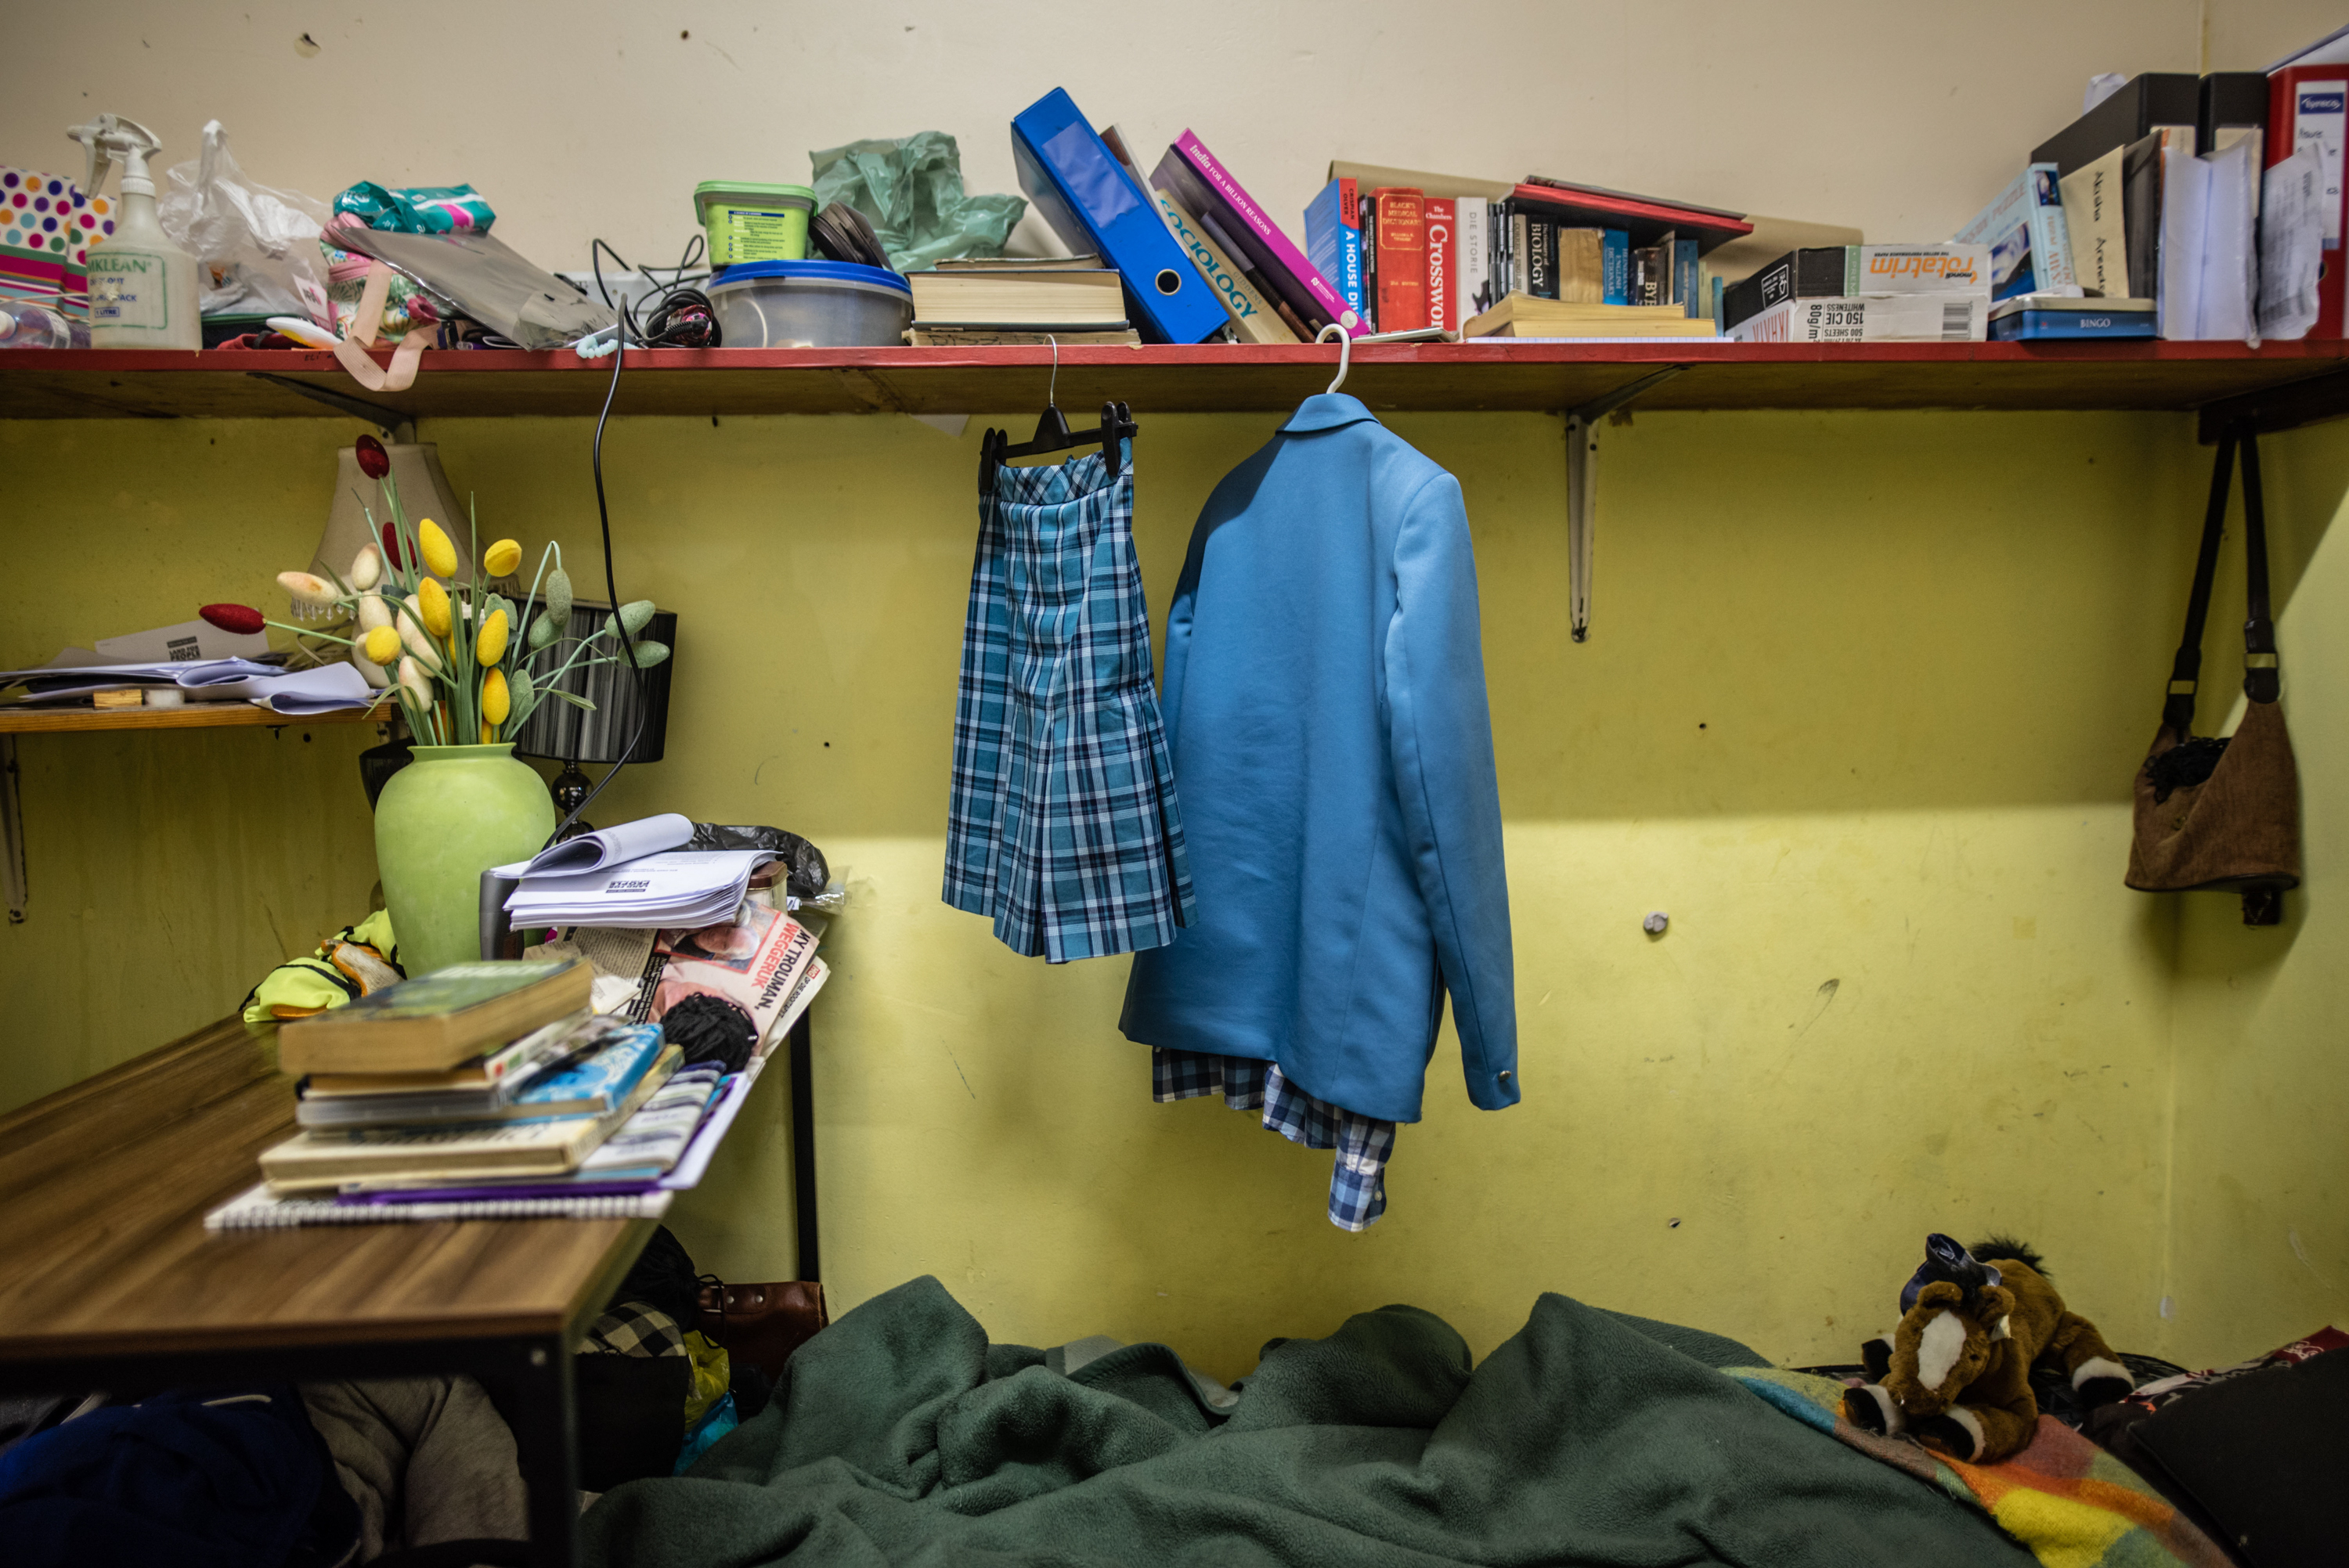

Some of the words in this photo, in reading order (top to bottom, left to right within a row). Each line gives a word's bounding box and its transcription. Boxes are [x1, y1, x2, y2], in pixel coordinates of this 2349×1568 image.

[1189, 144, 1211, 169] India
[1209, 167, 1222, 182] FOR
[1225, 184, 1247, 209] BILLION
[1246, 207, 1272, 236] REASONS
[1345, 231, 1355, 240] A
[1470, 235, 1478, 273] STORIE
[1531, 223, 1543, 287] BIOLOGY
[1346, 243, 1358, 288] HOUSE
[1870, 257, 1974, 279] rotatrim
[1233, 271, 1263, 305] GIDDENS
[1827, 303, 1865, 312] WHITENESS
[1826, 312, 1842, 325] CIE
[1846, 312, 1864, 325] 150
[2080, 319, 2111, 328] BINGO
[1850, 328, 1863, 337] 500
[793, 929, 811, 950] MY
[750, 922, 800, 989] WEGGERUK
[754, 949, 802, 1011] TROUMAN,
[806, 964, 821, 979] HG
